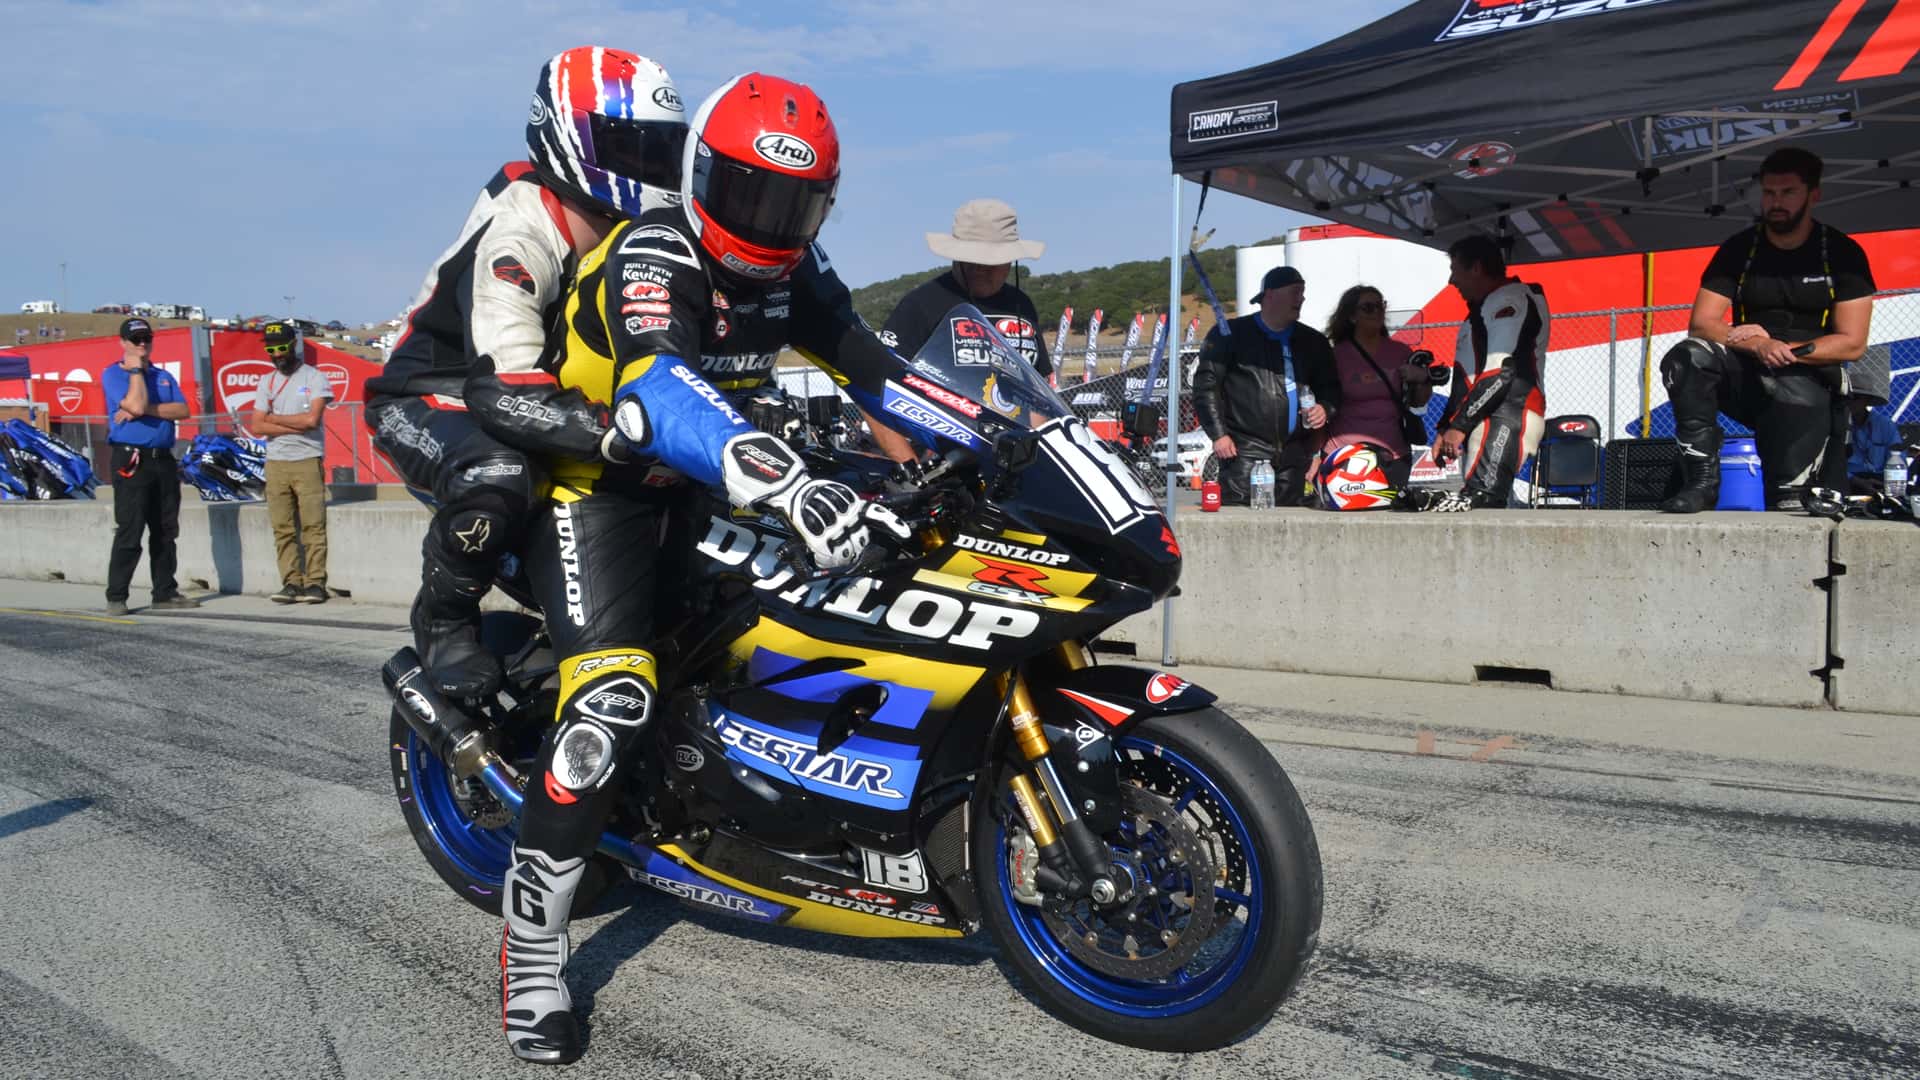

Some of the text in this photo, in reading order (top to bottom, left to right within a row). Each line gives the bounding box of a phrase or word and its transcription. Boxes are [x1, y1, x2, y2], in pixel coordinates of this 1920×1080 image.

[1194, 111, 1233, 130] CANOPY
[760, 138, 809, 162] Arai
[649, 265, 672, 278] WITH
[701, 353, 776, 371] DUNLO
[670, 365, 747, 425] SUZUKI
[1126, 378, 1167, 389] WRECH
[887, 399, 971, 446] ECSTAR
[953, 534, 1070, 565] DUNLOP
[553, 502, 587, 626] DUNLOP
[572, 655, 650, 679] RST
[588, 692, 645, 709] RST
[863, 848, 926, 892] 18
[631, 867, 770, 917] ECSTAR
[806, 890, 947, 925] DUNLOP
